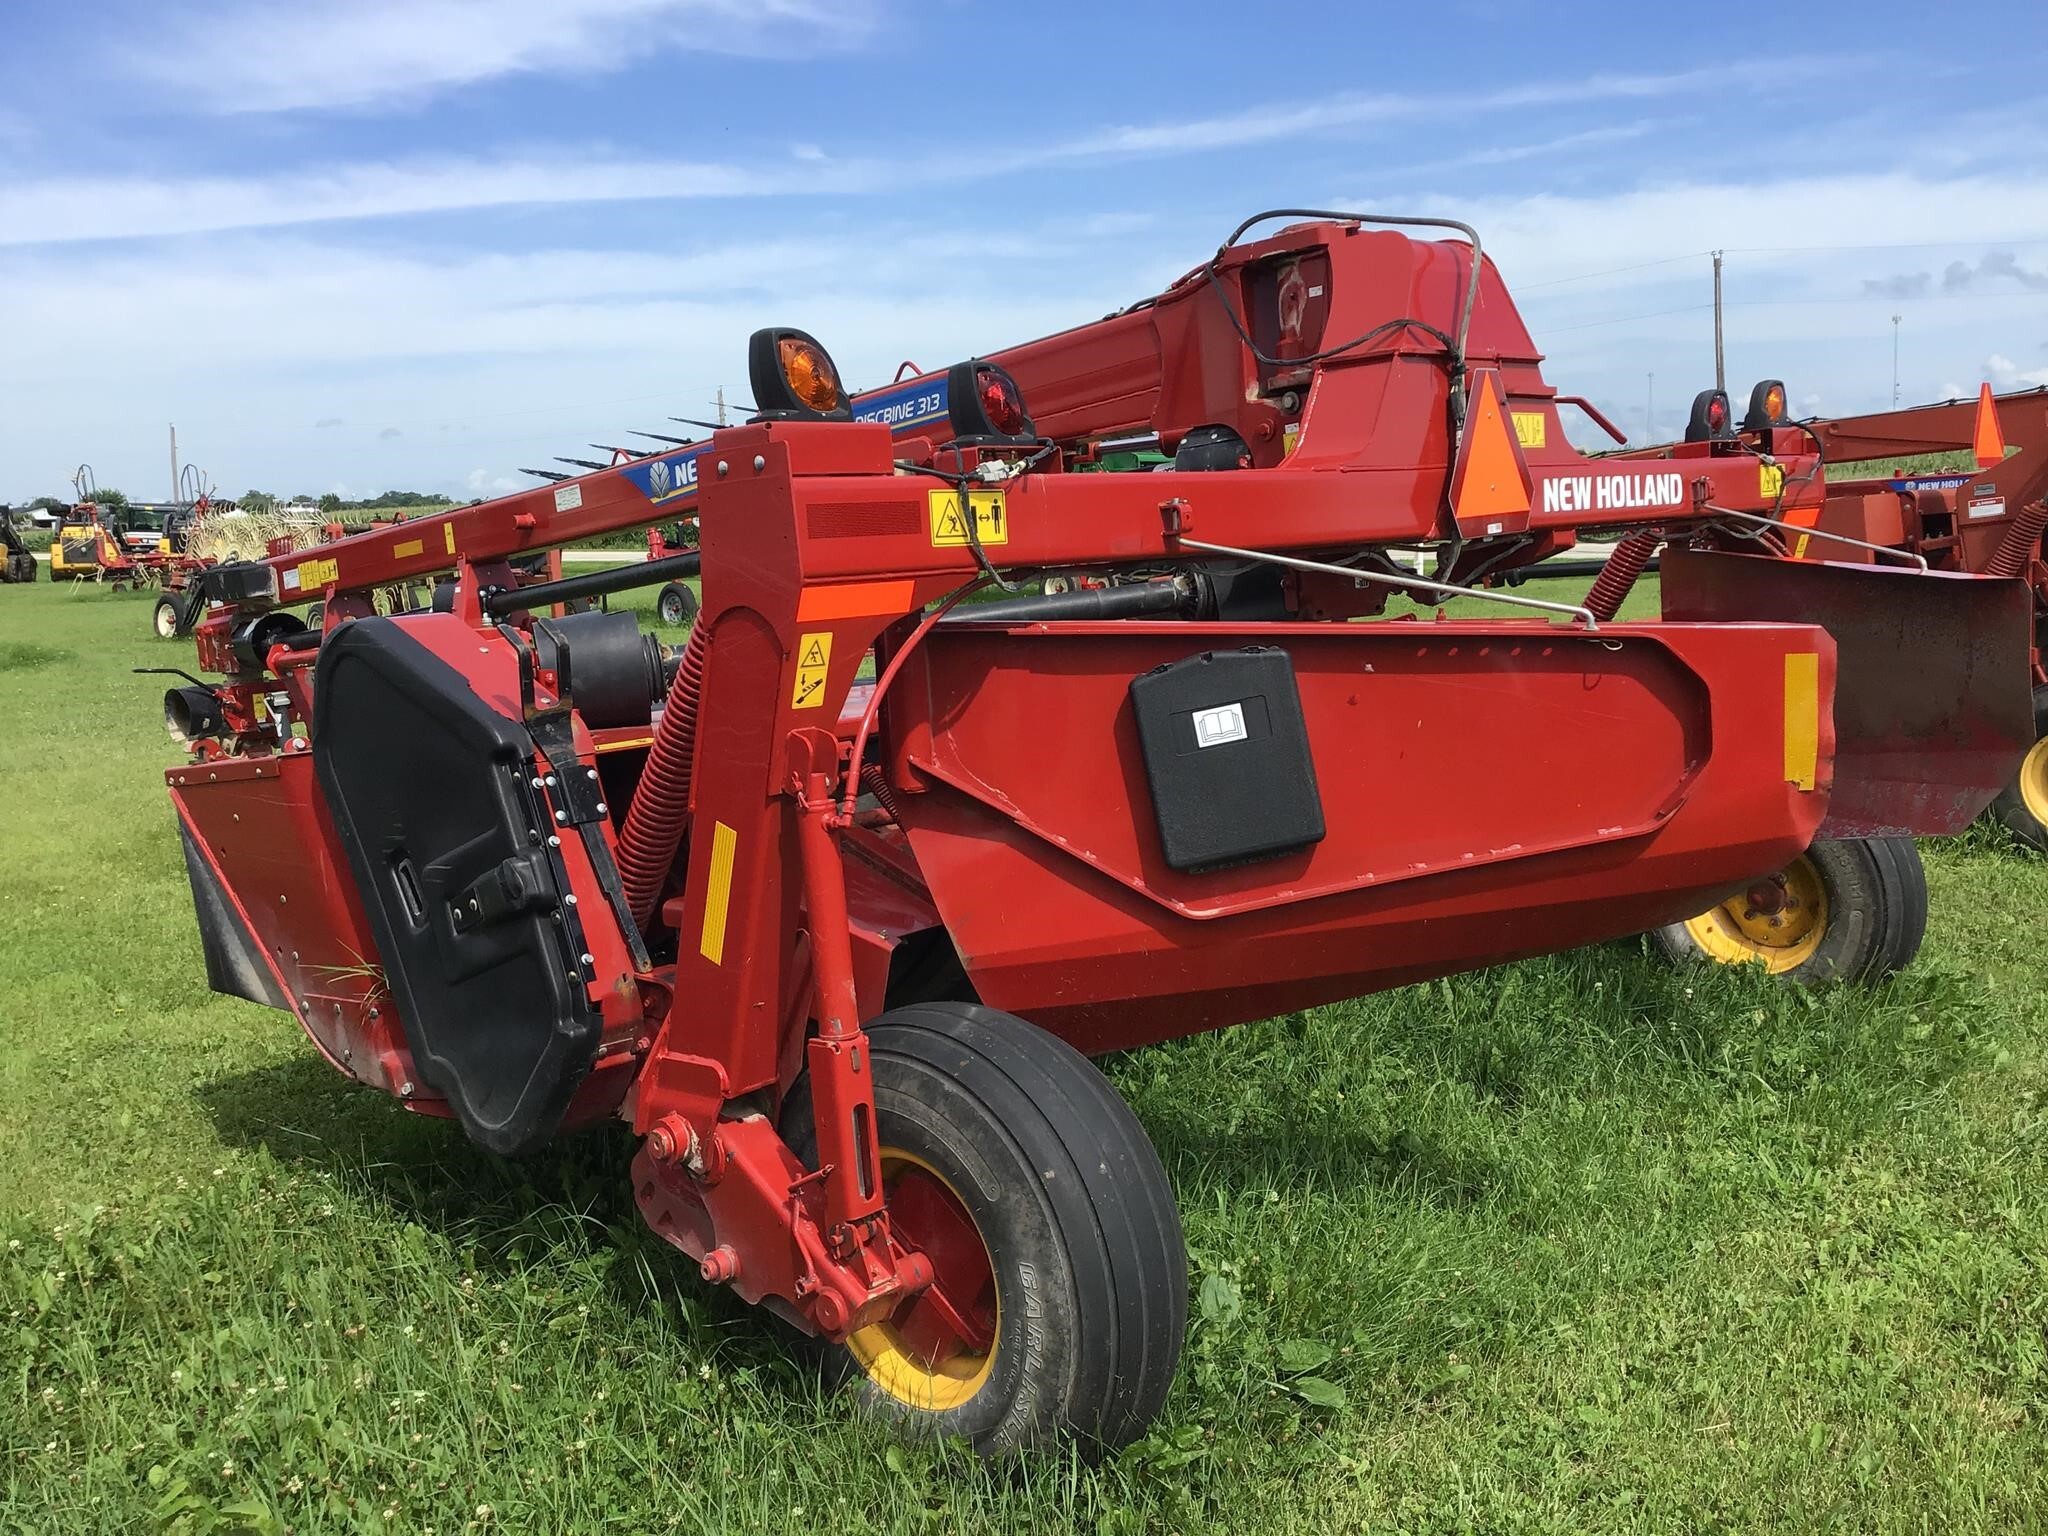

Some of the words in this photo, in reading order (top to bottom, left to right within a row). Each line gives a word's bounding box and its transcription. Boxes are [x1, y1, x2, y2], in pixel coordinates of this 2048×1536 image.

[917, 393, 940, 415] 313
[1543, 476, 1592, 512] NEW
[1596, 473, 1683, 509] HOLLAND
[1918, 481, 1940, 490] NEW
[993, 1262, 1043, 1447] CARLISLE
